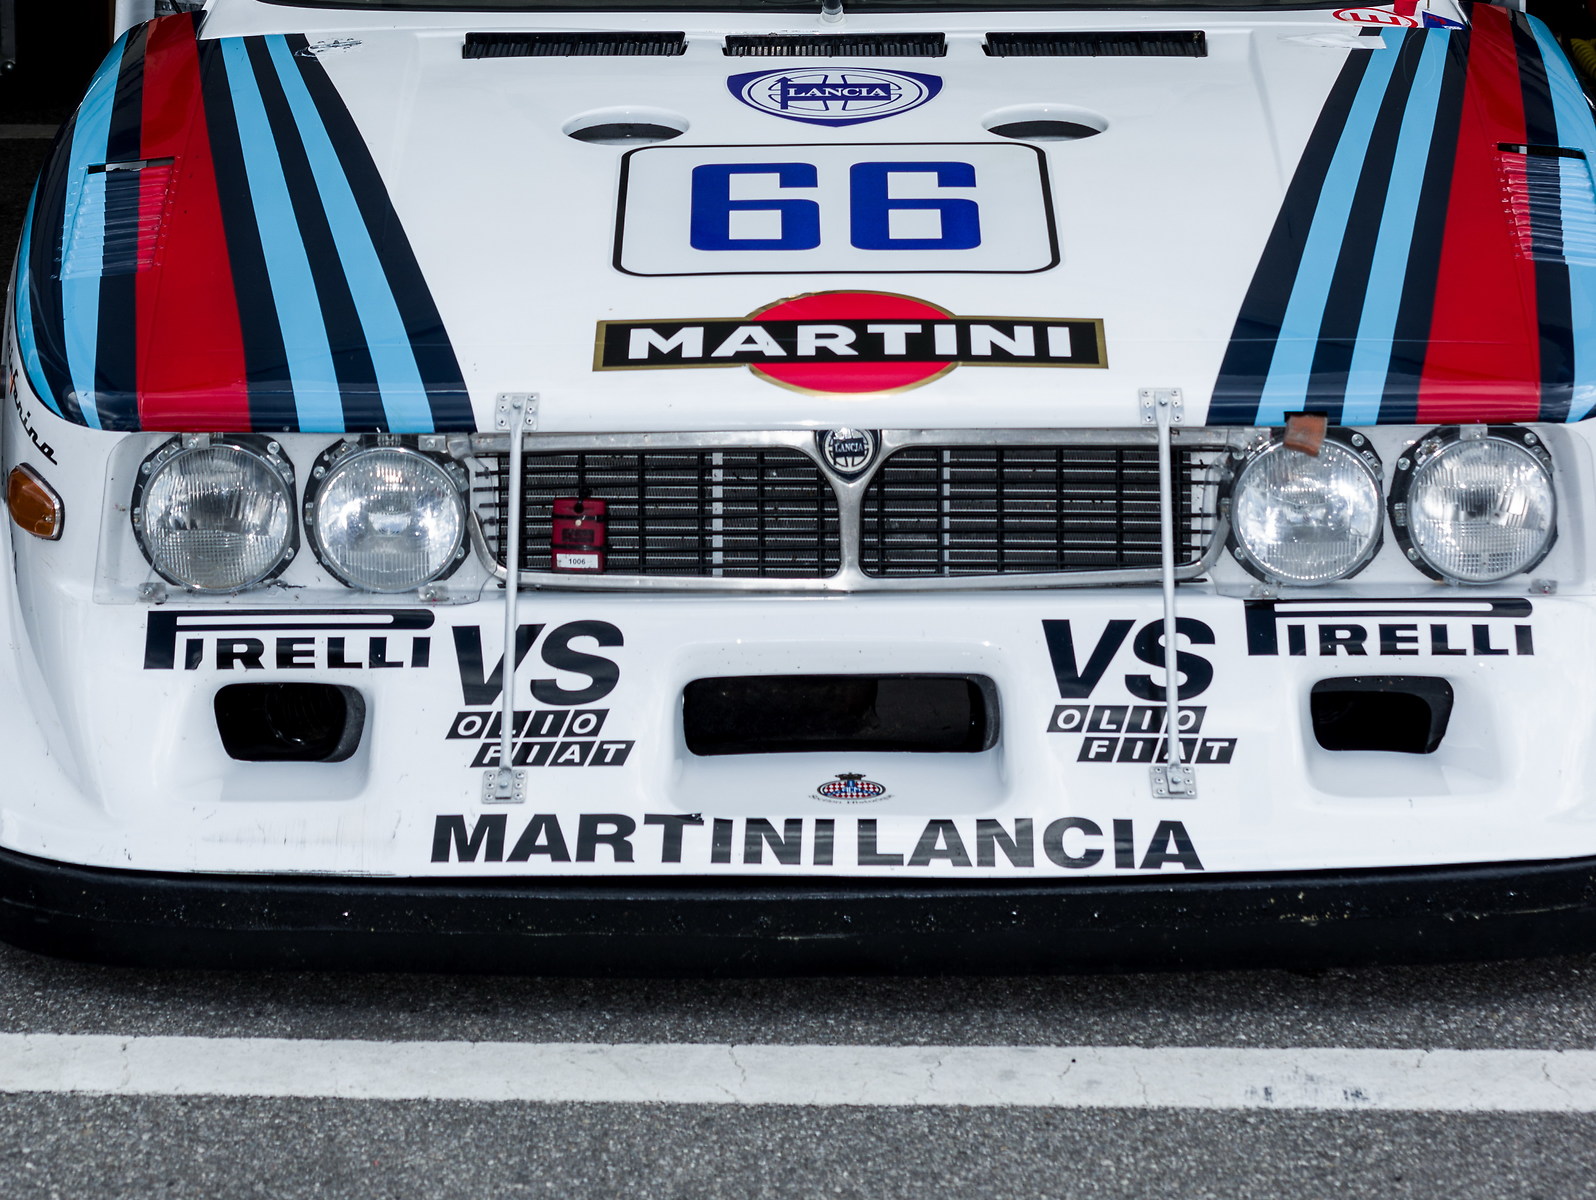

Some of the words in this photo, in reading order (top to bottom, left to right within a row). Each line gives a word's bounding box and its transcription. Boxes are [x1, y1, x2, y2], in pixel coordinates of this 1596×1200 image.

[786, 87, 889, 97] LANCIA
[690, 161, 982, 251] 66
[627, 323, 1073, 360] MARTINI
[834, 442, 864, 453] LANCIA
[143, 608, 436, 671] PIRELLI
[1243, 597, 1535, 657] PIRELLI
[451, 619, 625, 706] VS
[1041, 616, 1216, 702] VS
[457, 712, 598, 736] OIO
[1057, 708, 1196, 731] OLIO
[430, 812, 835, 866] MARTINI
[857, 816, 1205, 871] LANCIA
